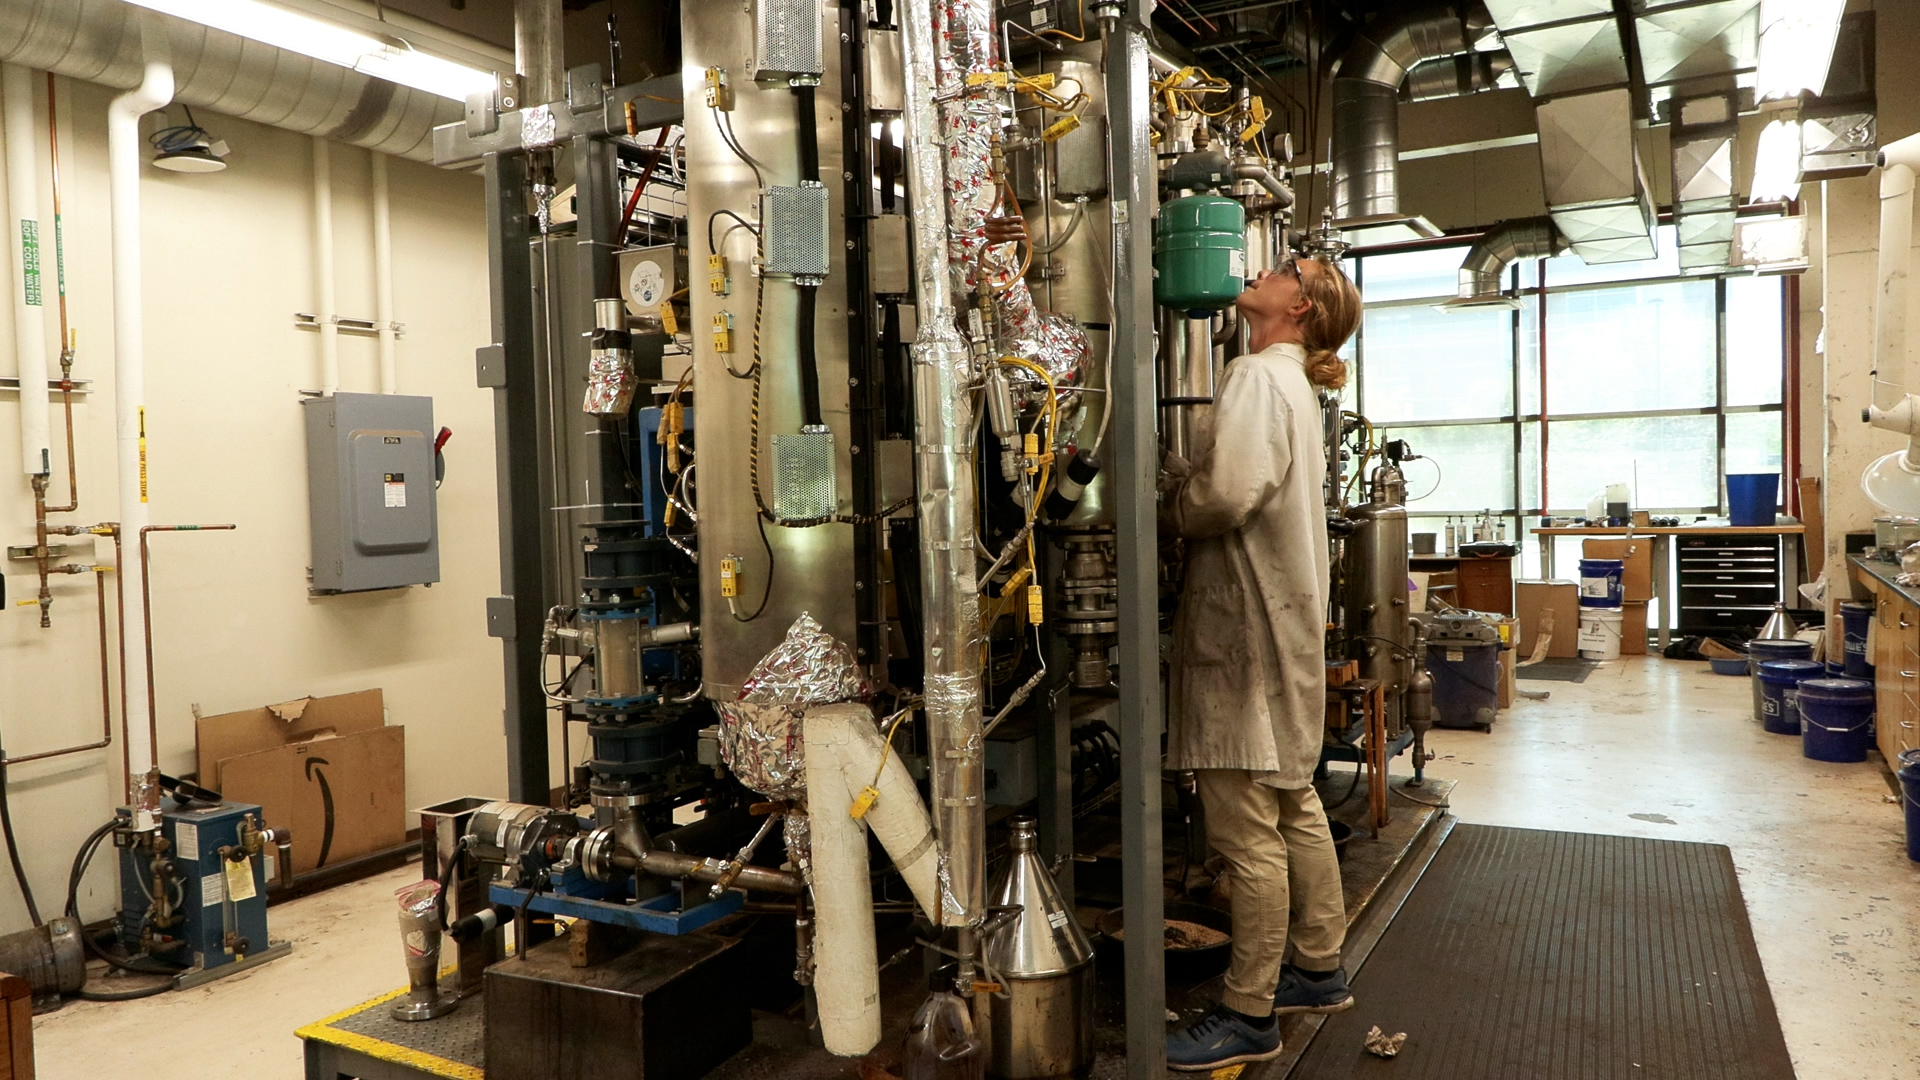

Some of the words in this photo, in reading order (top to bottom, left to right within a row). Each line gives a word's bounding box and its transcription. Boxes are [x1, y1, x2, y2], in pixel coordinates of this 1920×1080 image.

[22, 221, 32, 243] SOFT
[23, 246, 33, 270] COLD
[32, 247, 40, 271] COLD
[1845, 640, 1867, 652] OWE'S
